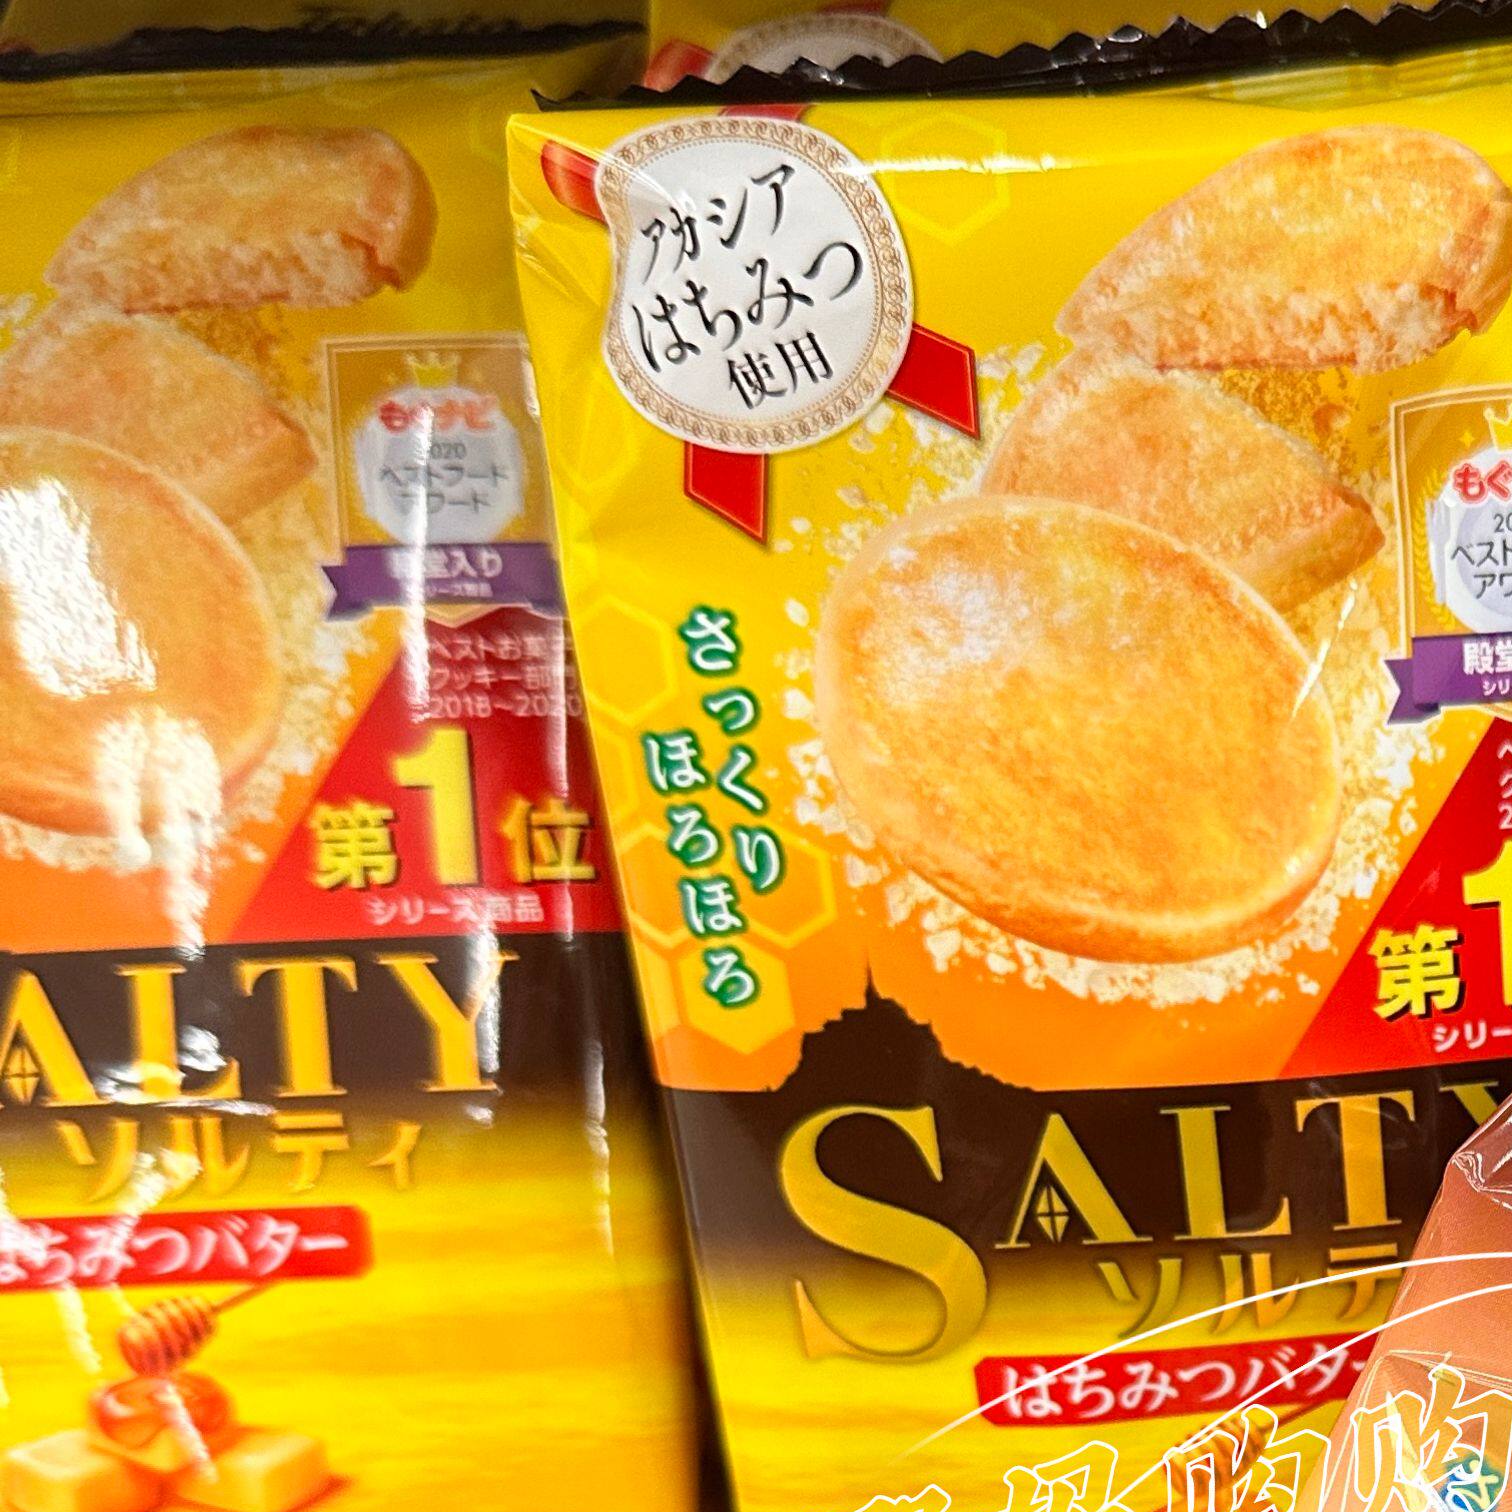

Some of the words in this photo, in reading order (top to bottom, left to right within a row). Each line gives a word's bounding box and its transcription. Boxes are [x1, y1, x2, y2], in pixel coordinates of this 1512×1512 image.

[640, 163, 796, 284] アカシア
[632, 240, 865, 373] はちみつ
[726, 330, 834, 410] 使用
[308, 726, 599, 891] 第1位
[681, 605, 784, 892] さっくり
[643, 729, 759, 1008] ほろほろ
[54, 1110, 423, 1203] ソルティ
